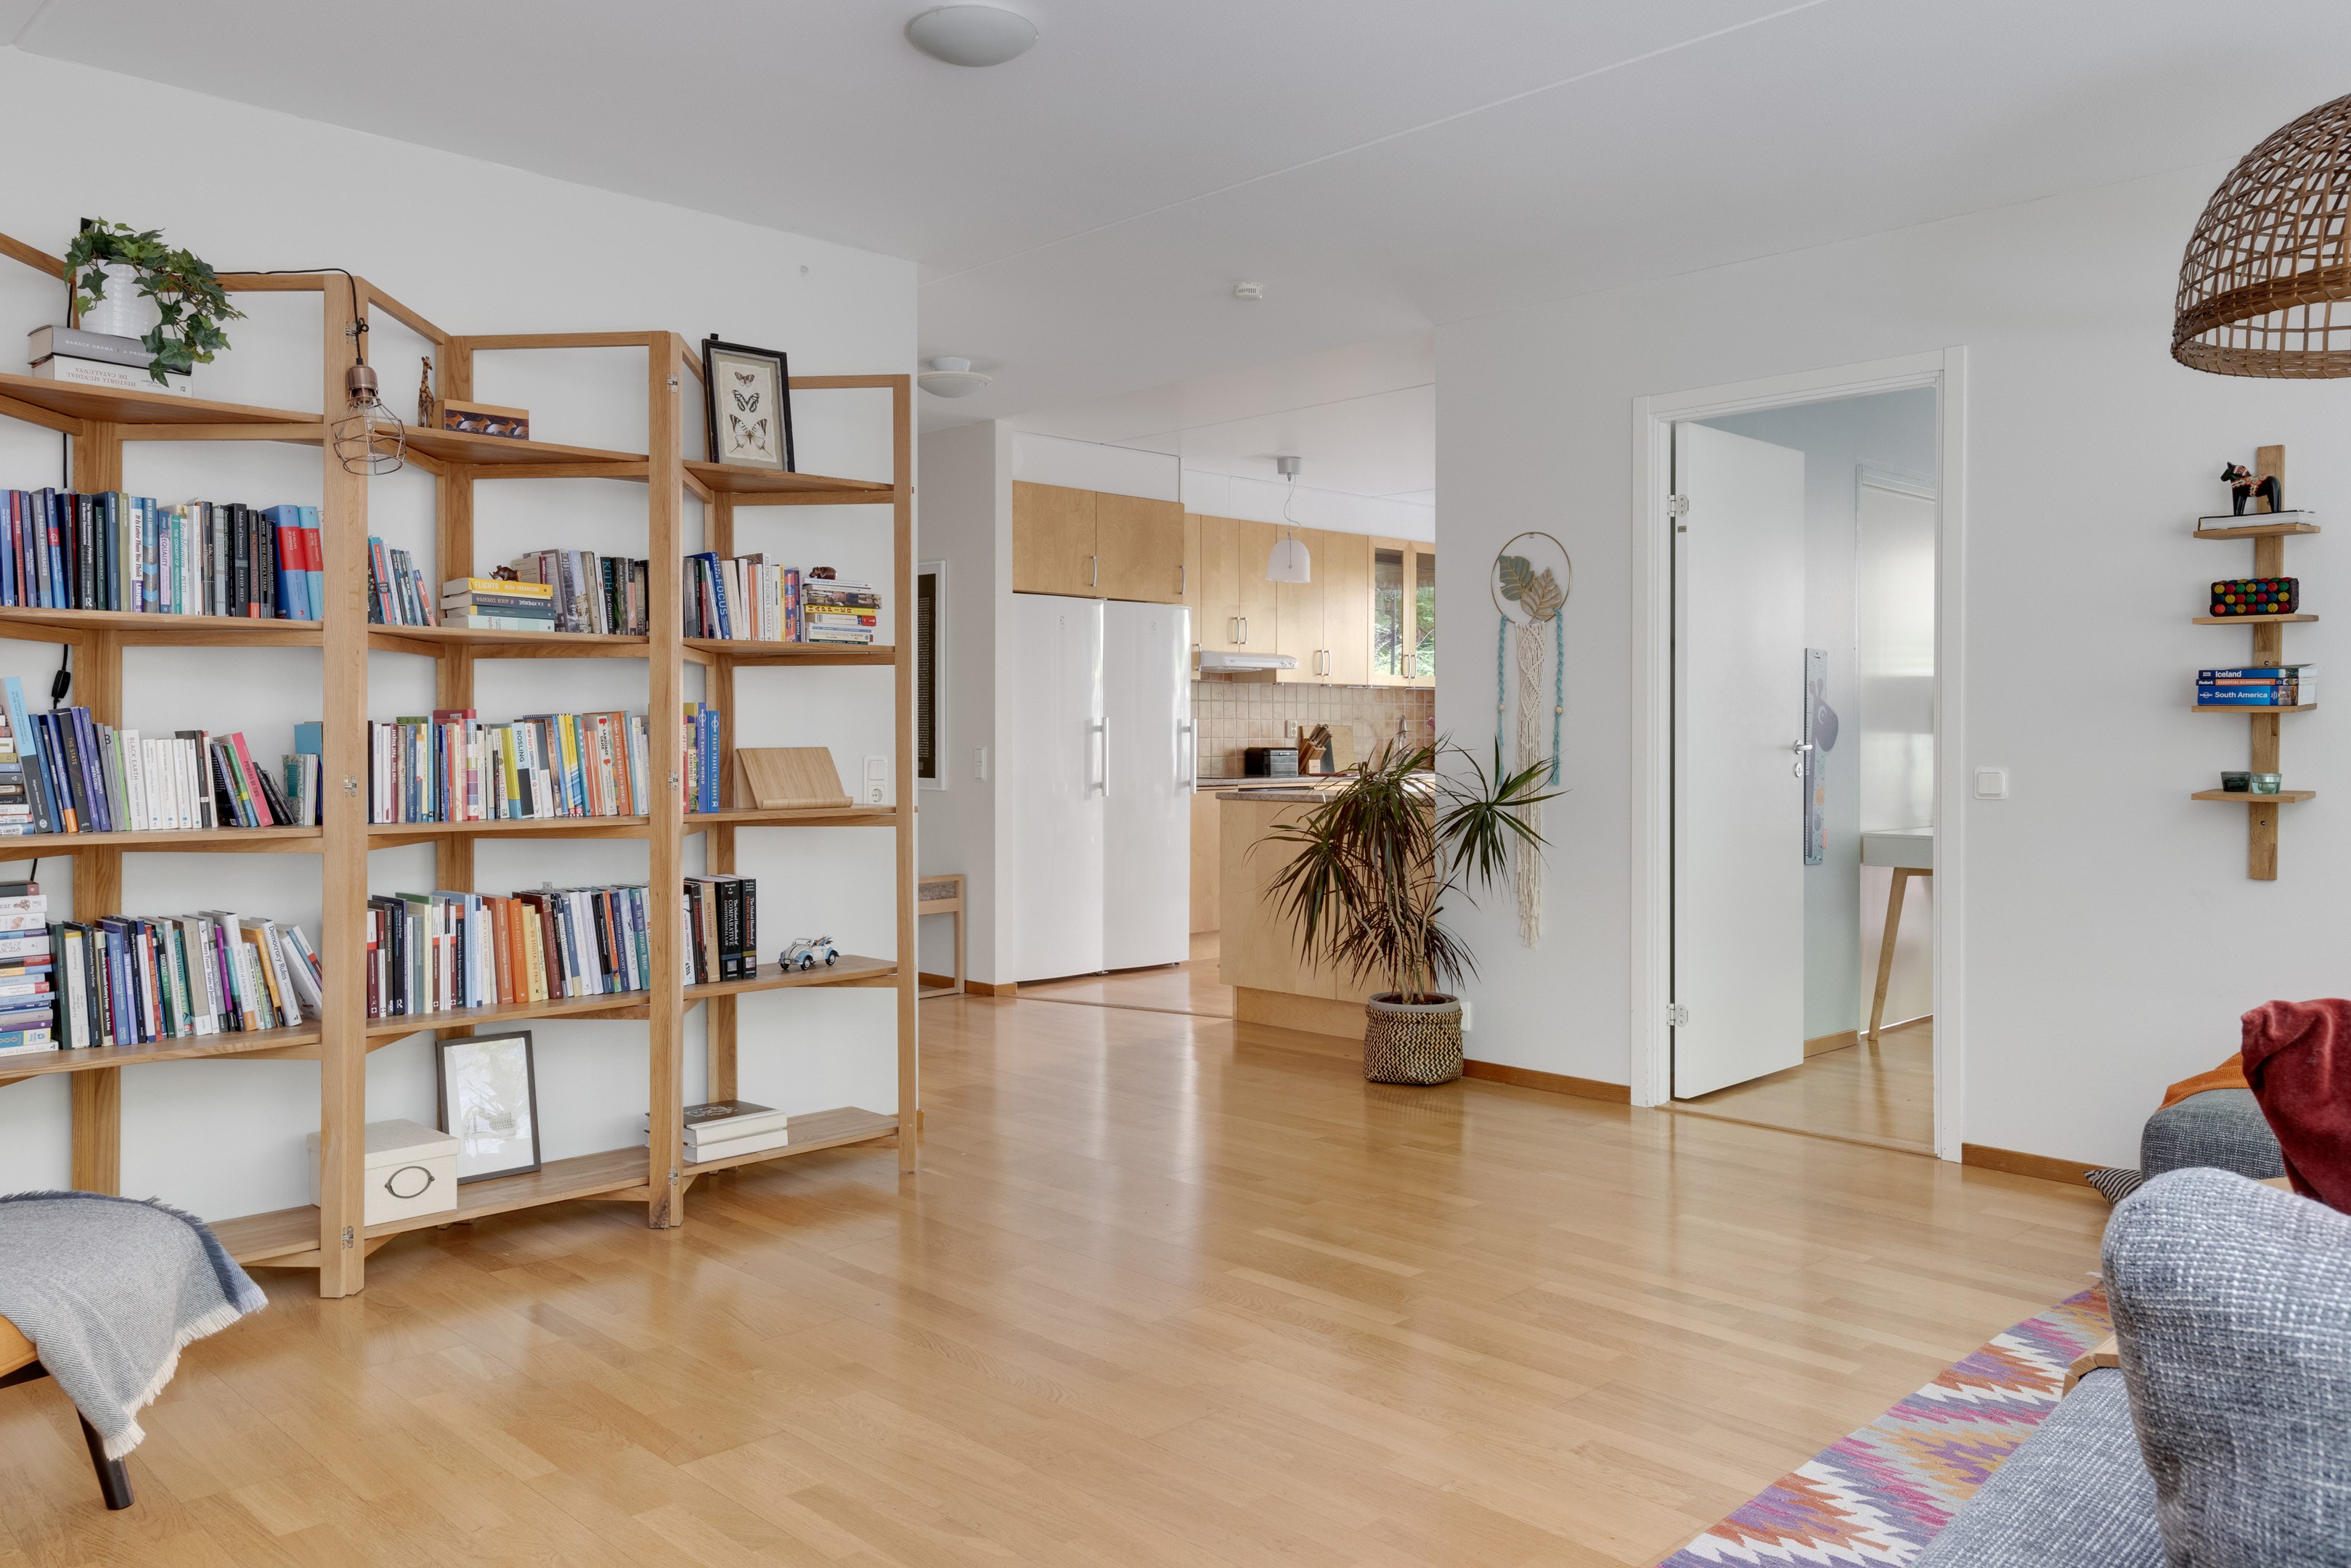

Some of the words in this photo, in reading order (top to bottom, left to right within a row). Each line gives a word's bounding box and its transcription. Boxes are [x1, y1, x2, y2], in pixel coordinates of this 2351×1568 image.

[66, 372, 99, 381] MUNDIAL
[76, 367, 116, 377] CATALUNYA
[603, 561, 612, 590] KITH
[716, 579, 727, 615] FOCUS
[516, 730, 525, 762] ROSLING
[244, 761, 253, 780] POWERS
[268, 926, 282, 962] Democracy
[628, 935, 637, 971] DEMOCRACY
